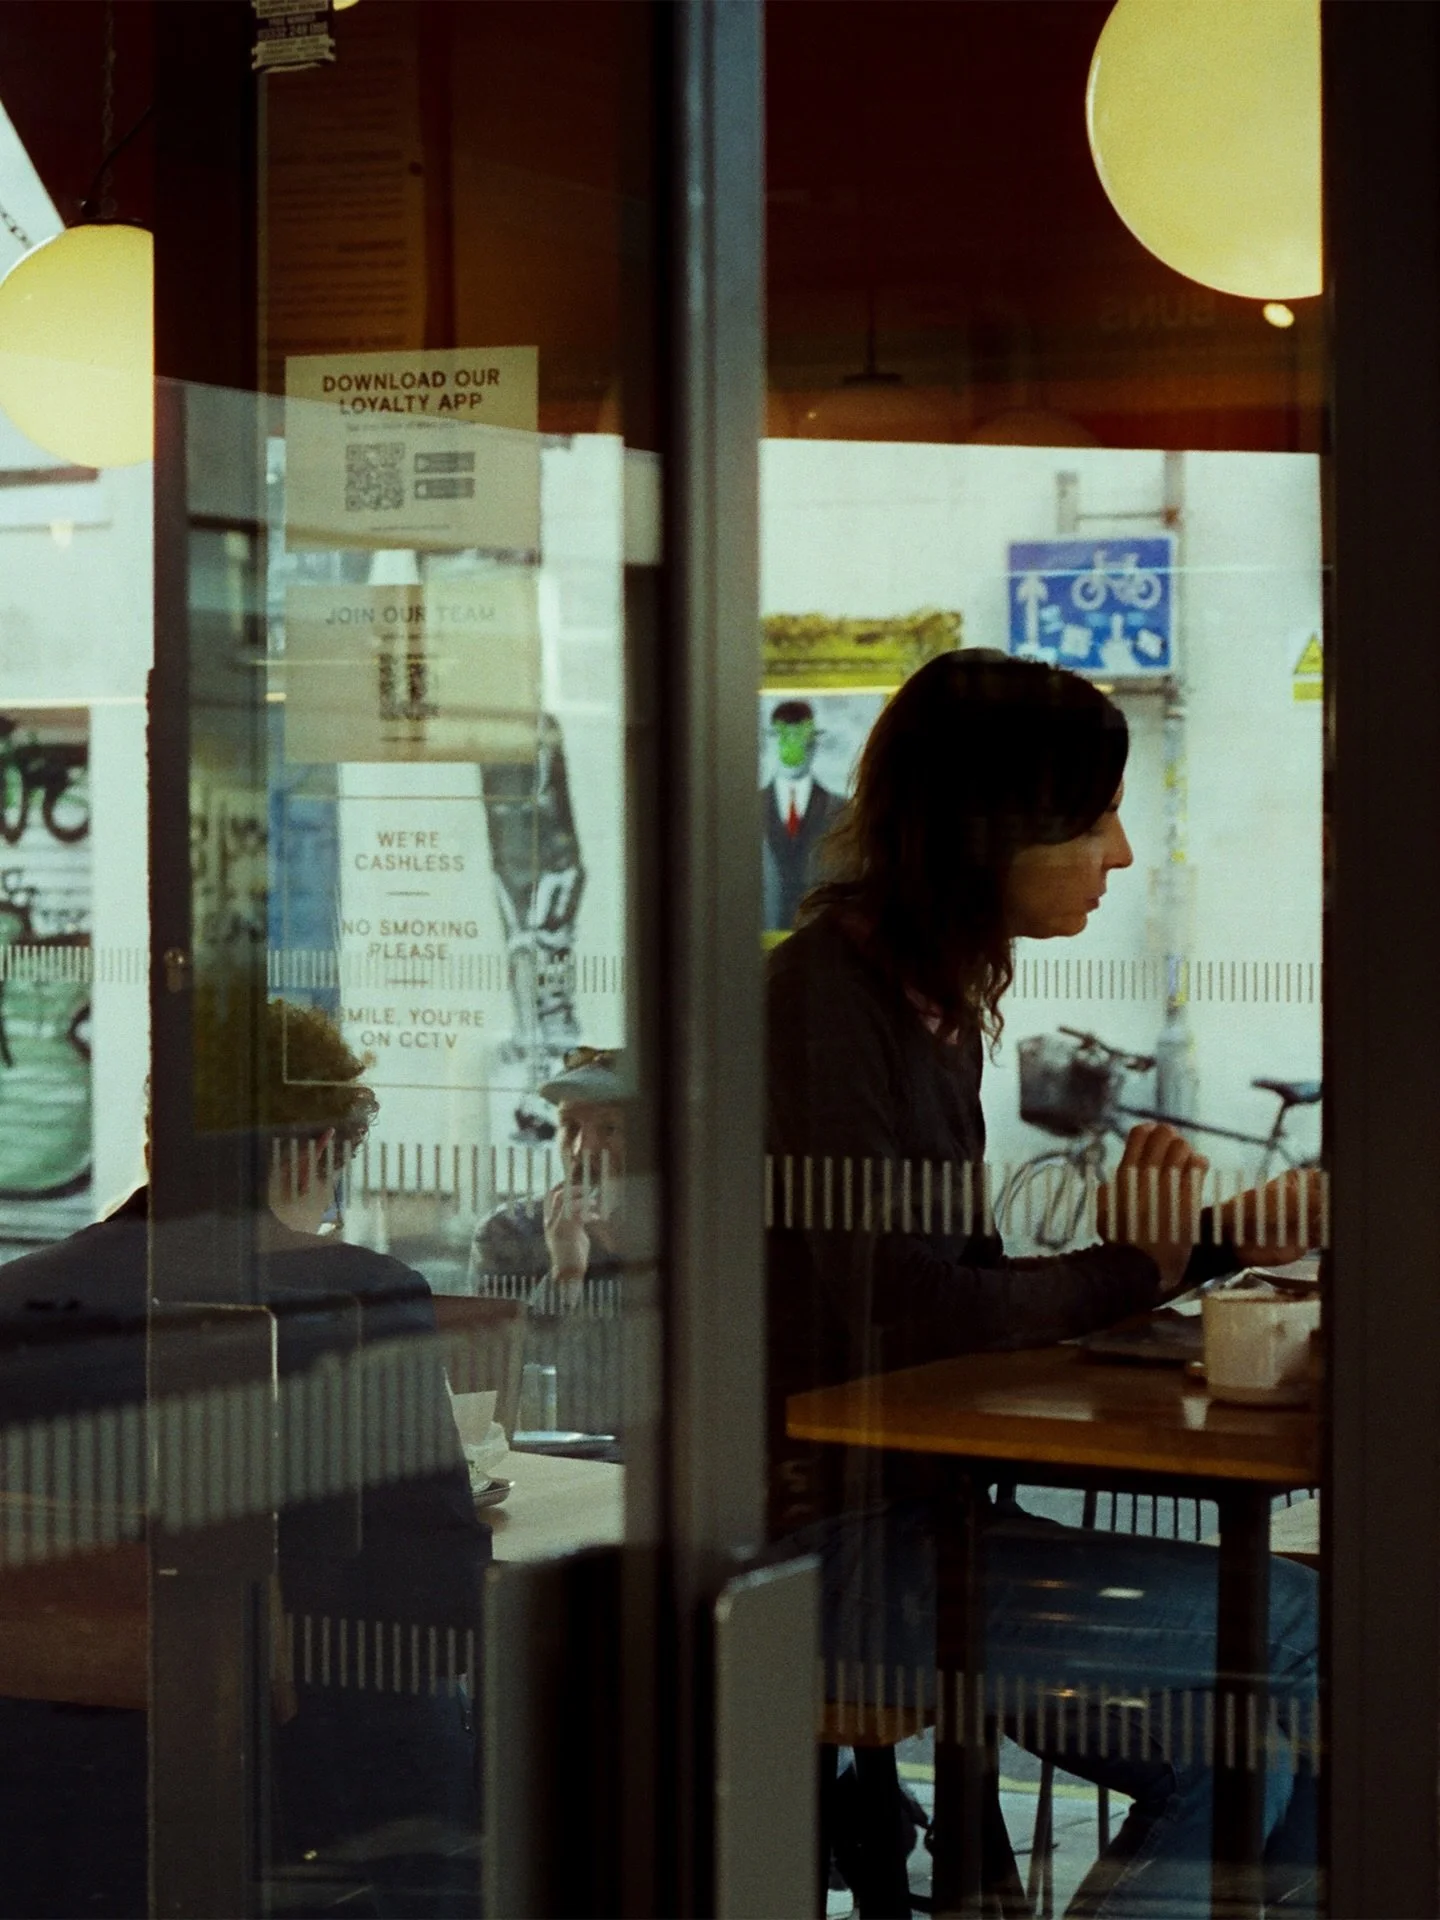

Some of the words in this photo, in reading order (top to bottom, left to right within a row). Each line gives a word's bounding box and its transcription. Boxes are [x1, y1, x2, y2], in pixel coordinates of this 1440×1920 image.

[322, 370, 446, 393] DOWNLOAD
[454, 368, 500, 387] OUR
[339, 394, 430, 415] LOYALTY
[438, 393, 483, 411] APP
[325, 606, 376, 625] JOIN
[381, 605, 426, 624] OUR
[435, 604, 496, 624] TEAM
[376, 831, 440, 849] WE'RE
[354, 853, 466, 872] CASHLESS
[341, 918, 371, 937] NO
[379, 919, 478, 938] SMOKING
[367, 942, 449, 961] PLEASE
[409, 1007, 485, 1027] YOU'RE
[360, 1031, 391, 1048] ON
[399, 1031, 458, 1049] CCTV
